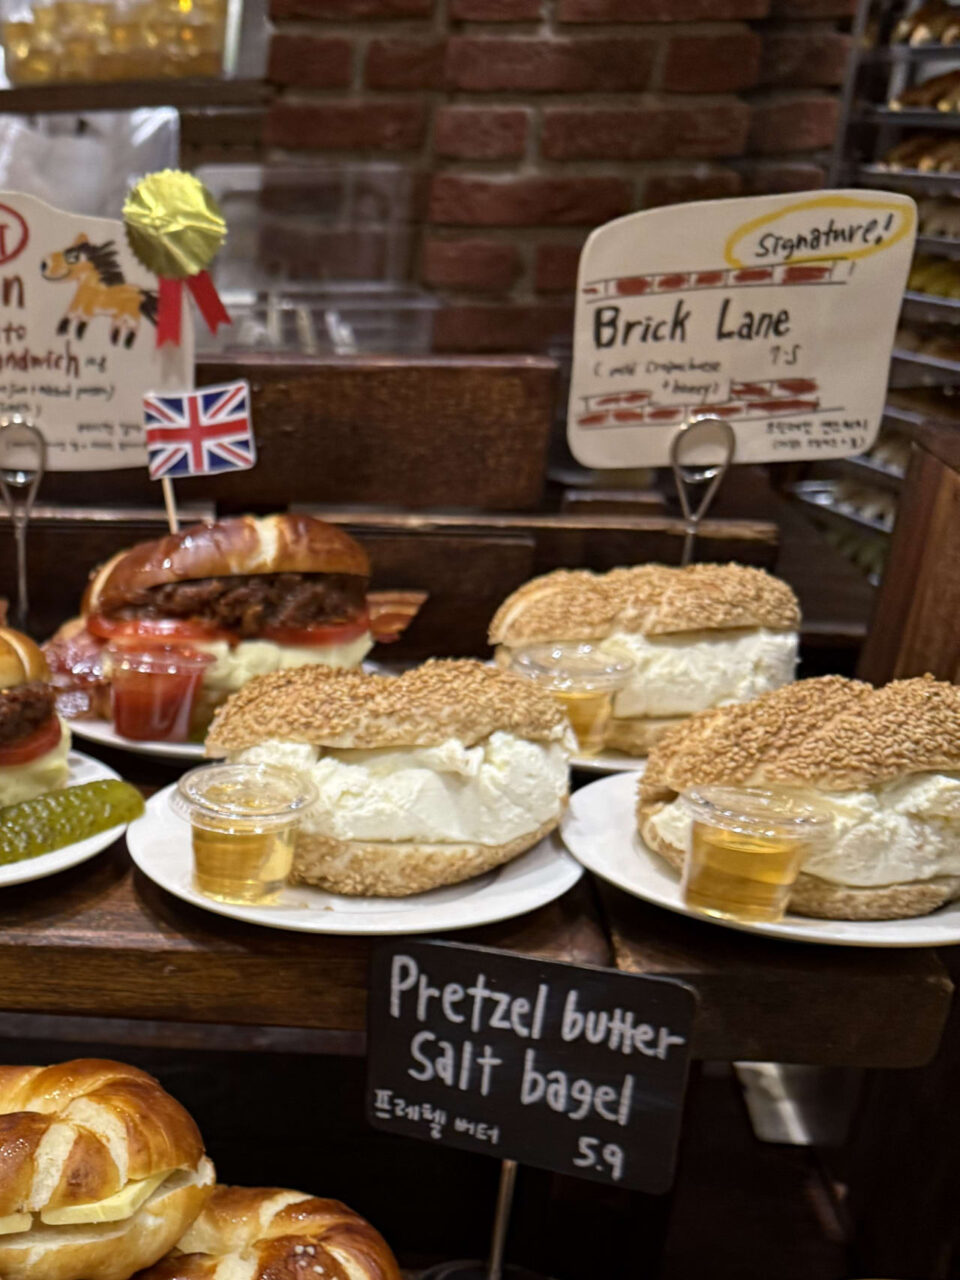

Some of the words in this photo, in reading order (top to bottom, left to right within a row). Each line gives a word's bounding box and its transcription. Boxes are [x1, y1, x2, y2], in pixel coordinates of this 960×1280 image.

[755, 213, 894, 259] Signature!
[593, 299, 691, 349] Brick
[716, 299, 790, 341] Lane
[390, 954, 549, 1040] Pretzel
[561, 989, 686, 1060] butter
[519, 1048, 635, 1126] bagel
[453, 1116, 500, 1145] 버터
[572, 1136, 625, 1181] 5.9
